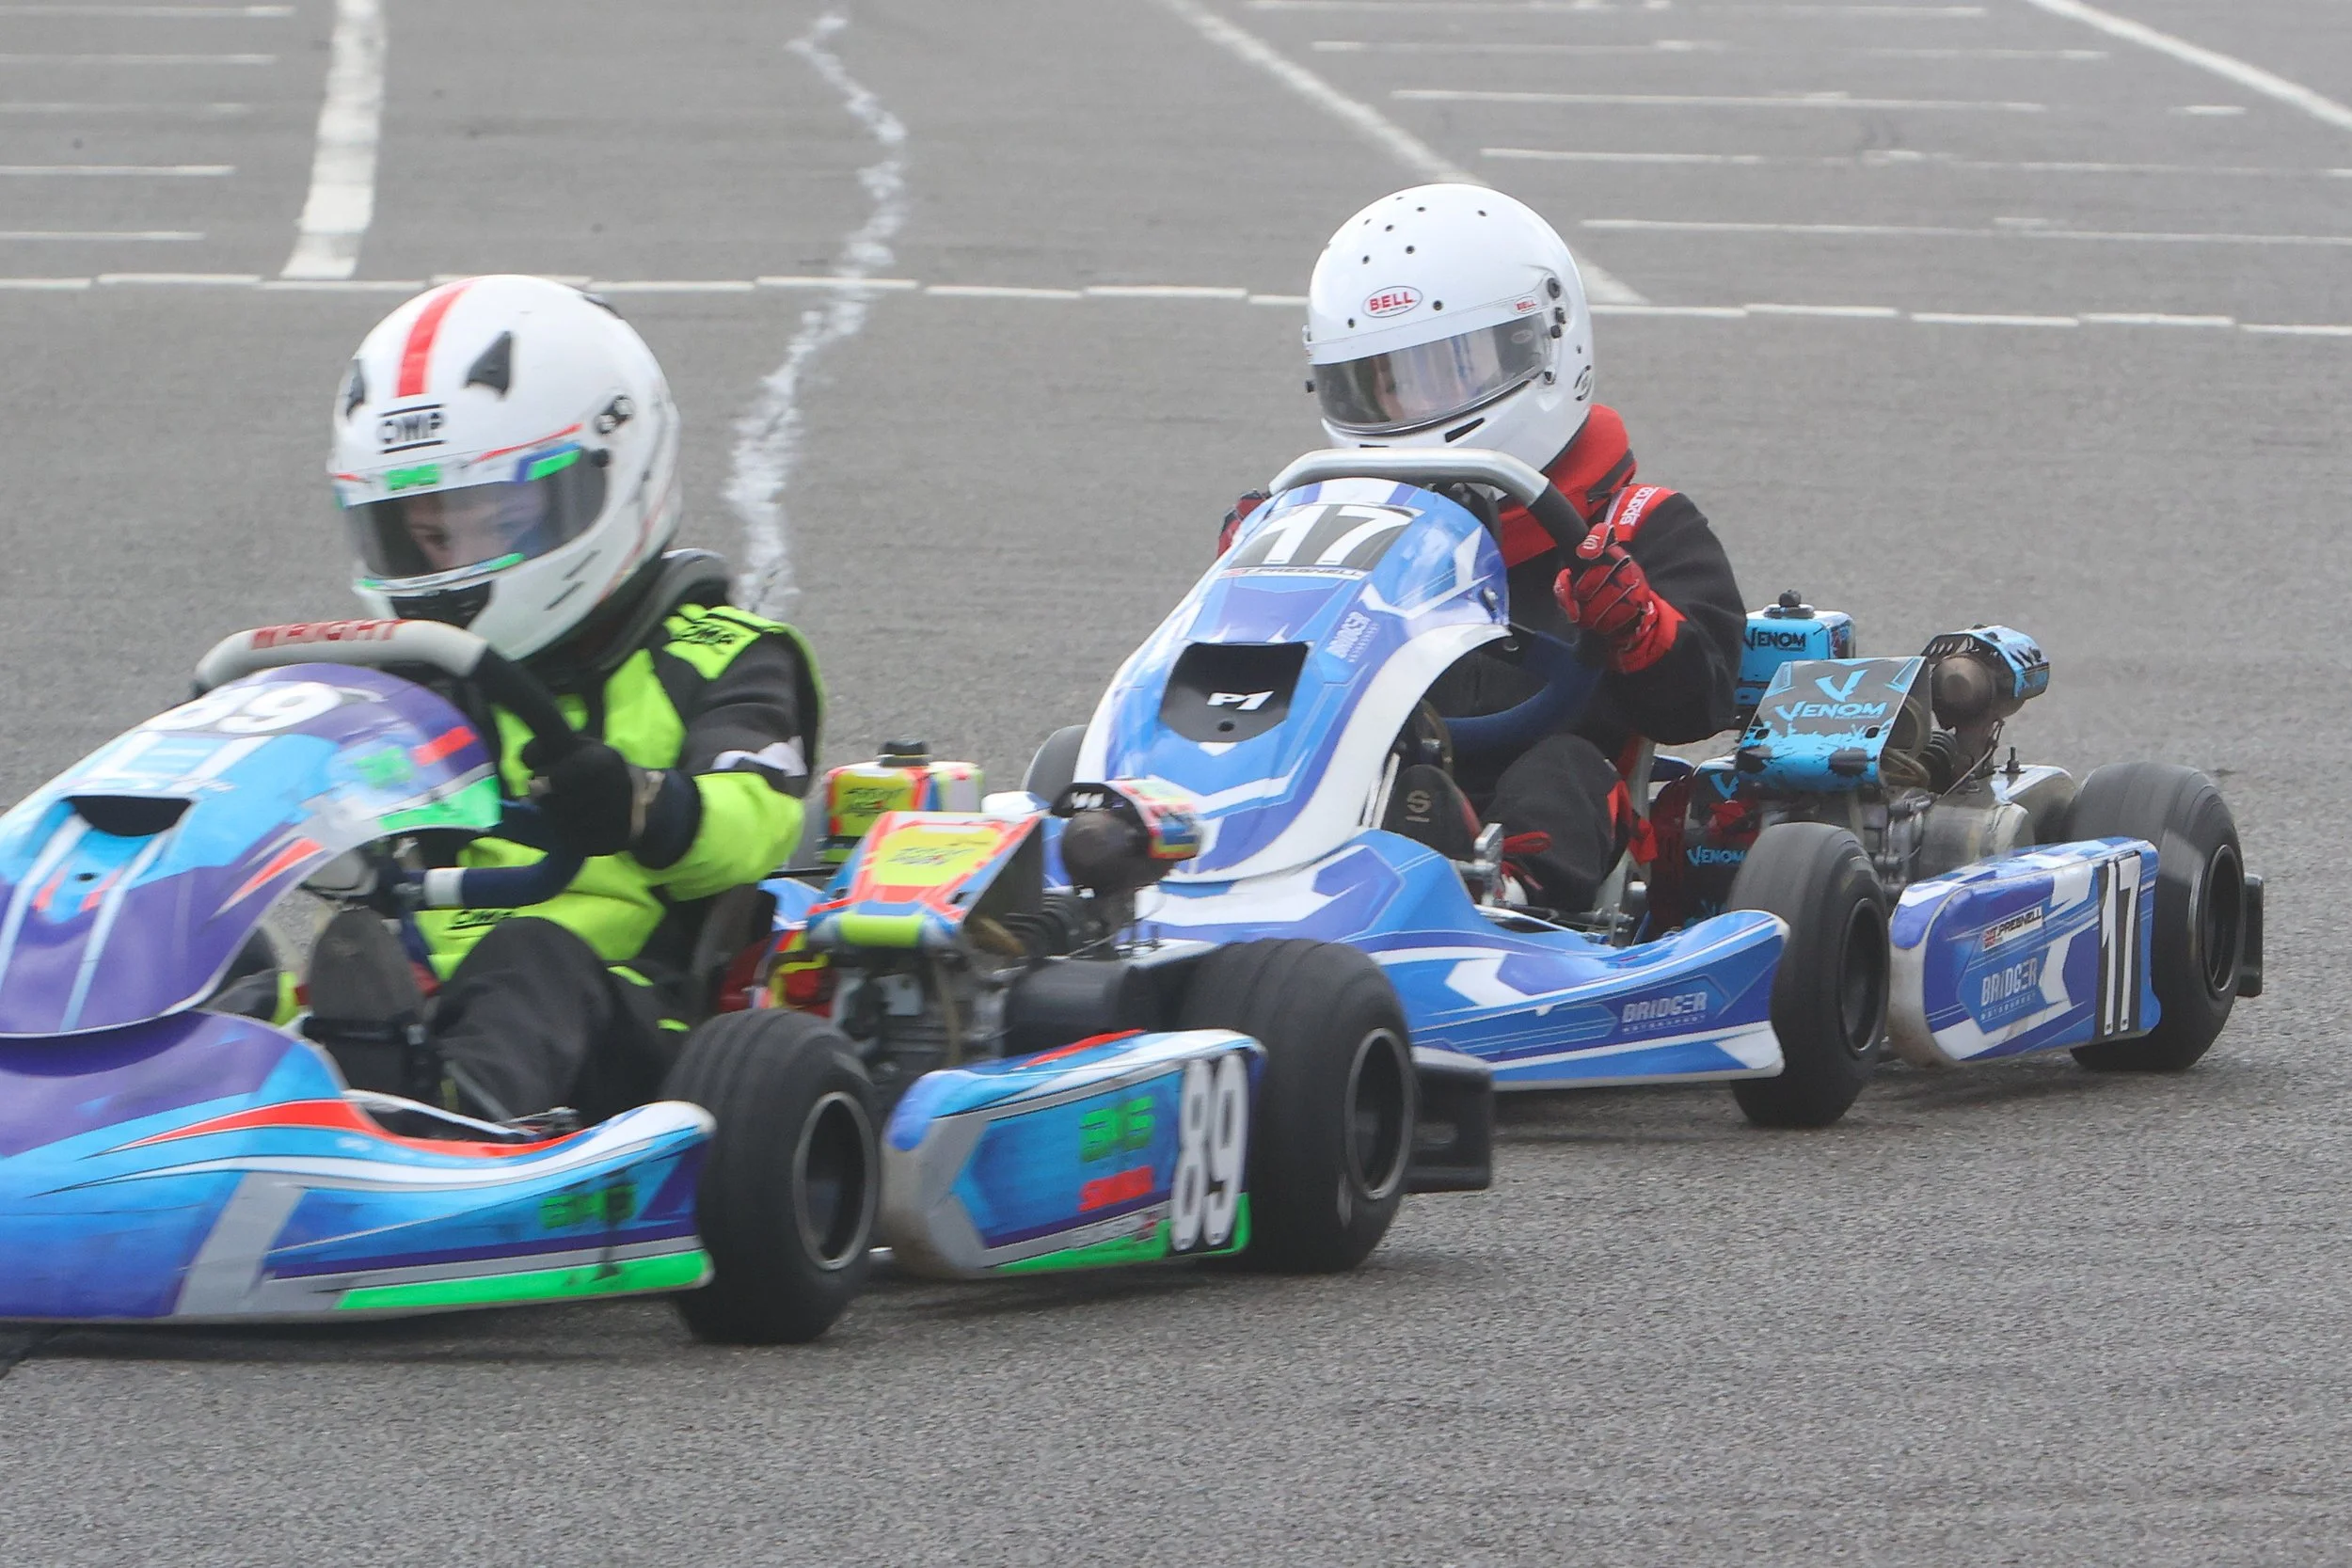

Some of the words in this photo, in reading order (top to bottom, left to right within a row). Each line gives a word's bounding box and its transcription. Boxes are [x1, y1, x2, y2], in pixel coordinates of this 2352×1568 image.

[1369, 291, 1413, 311] BELL
[1515, 300, 1536, 311] BELL
[376, 411, 446, 443] OMP
[1243, 504, 1415, 565] 17
[1743, 626, 1806, 651] VENOM
[1206, 690, 1275, 711] P1
[1774, 701, 1889, 721] VENOM
[2101, 854, 2141, 1036] 17
[1980, 958, 2038, 1006] BRIDGER
[1621, 991, 1708, 1023] BRIDGER
[1170, 1053, 1248, 1252] 89
